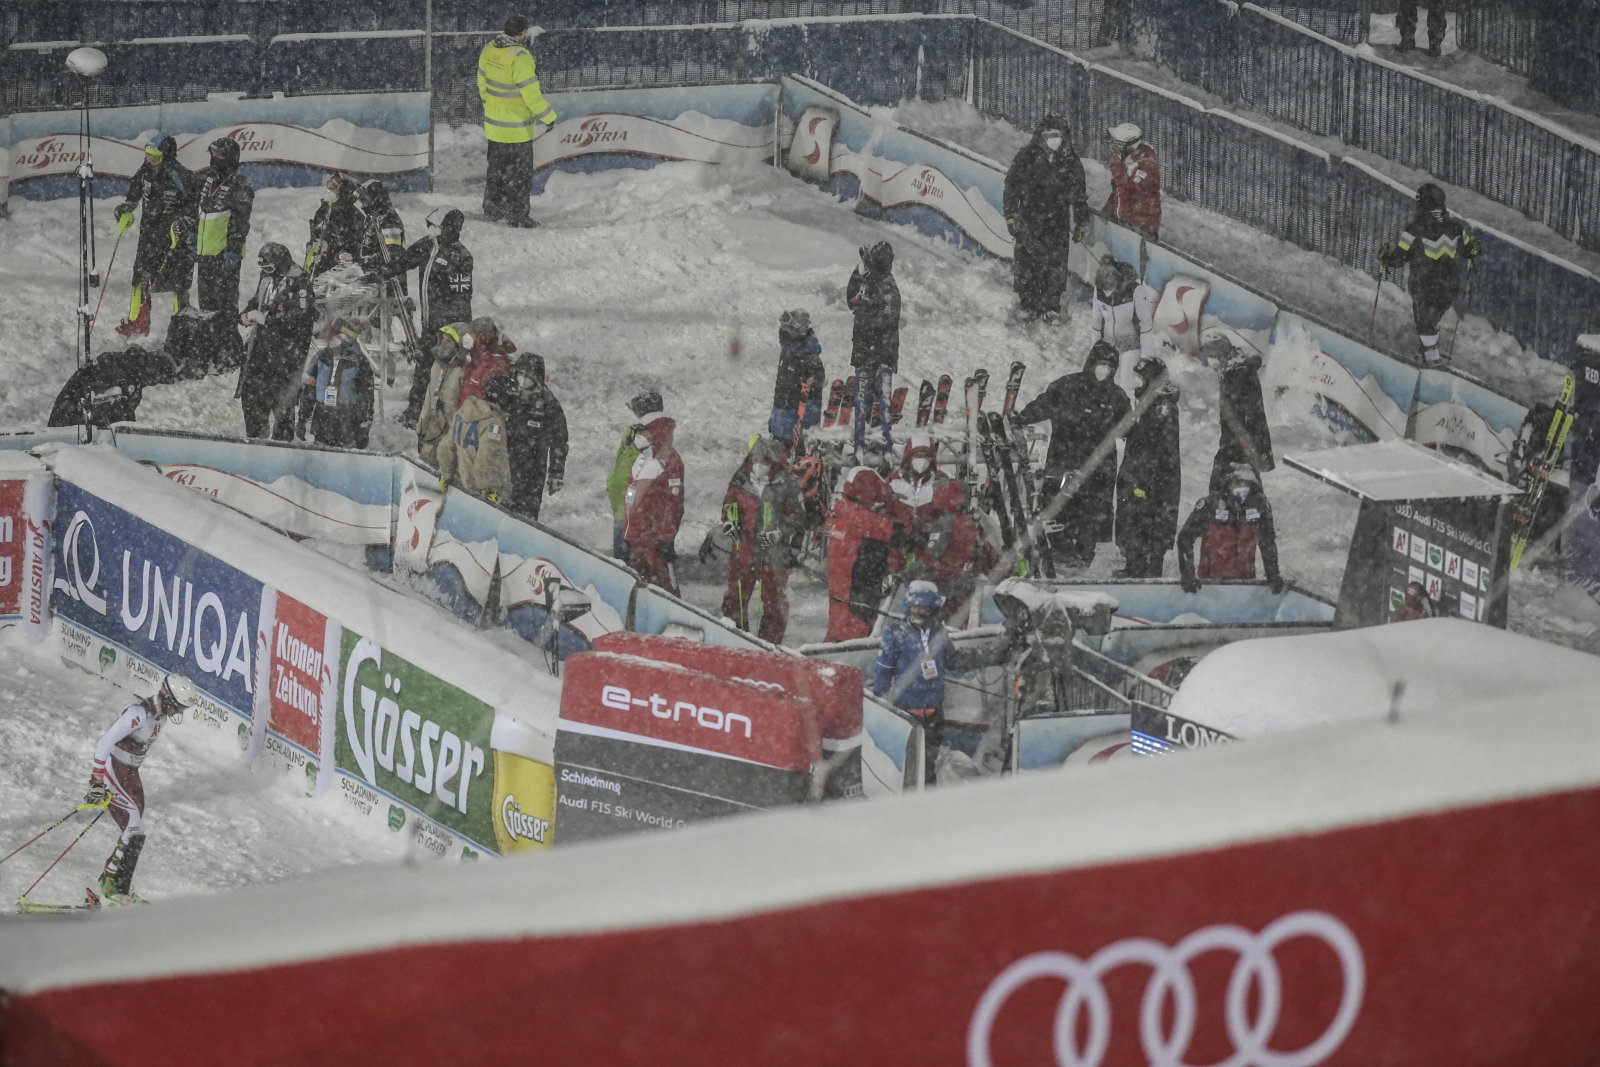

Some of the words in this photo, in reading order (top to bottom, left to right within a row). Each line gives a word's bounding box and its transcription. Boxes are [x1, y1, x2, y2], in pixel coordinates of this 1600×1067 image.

[559, 131, 628, 148] AUSTRIA
[1413, 511, 1431, 526] Audi
[1432, 518, 1445, 533] FIS
[1459, 531, 1482, 551] World
[30, 552, 43, 625] AUSTRIA
[122, 549, 253, 695] UNIQA
[277, 622, 322, 681] Kronen
[275, 663, 318, 726] Zeitung
[602, 685, 752, 738] e-tron
[344, 637, 485, 815] Gösser
[561, 768, 622, 796] Schladming
[502, 794, 549, 843] Gösser
[558, 794, 588, 810] Audi
[591, 800, 612, 815] FIS
[614, 805, 633, 820] Ski
[635, 810, 674, 829] World
